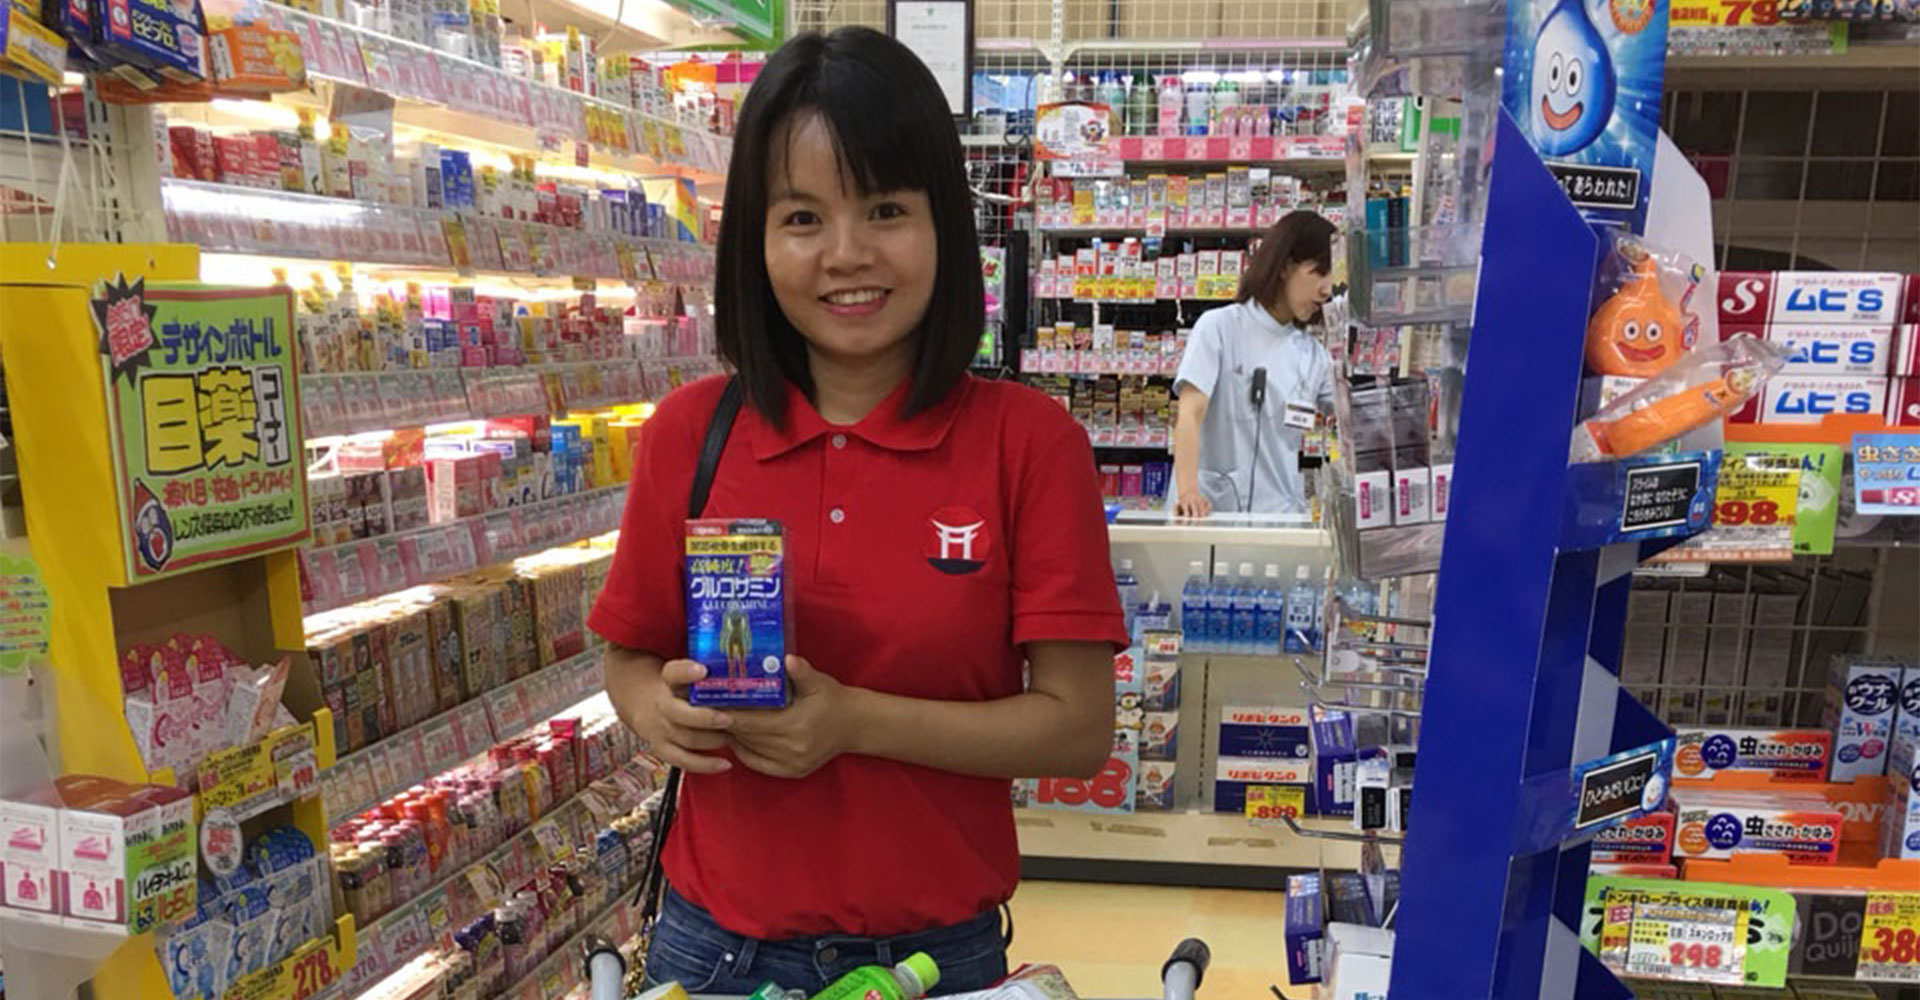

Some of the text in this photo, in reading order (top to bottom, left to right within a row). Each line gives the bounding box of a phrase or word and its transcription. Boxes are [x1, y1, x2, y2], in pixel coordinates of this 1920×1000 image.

[1720, 0, 1797, 26] 79
[1722, 279, 1765, 315] S
[142, 366, 260, 476] 目薬
[262, 373, 284, 460] コーナー
[691, 576, 781, 599] グルコサミン
[1669, 942, 1723, 968] 298
[1870, 927, 1920, 964] 38
[293, 947, 330, 1000] 278
[351, 955, 377, 983] 370
